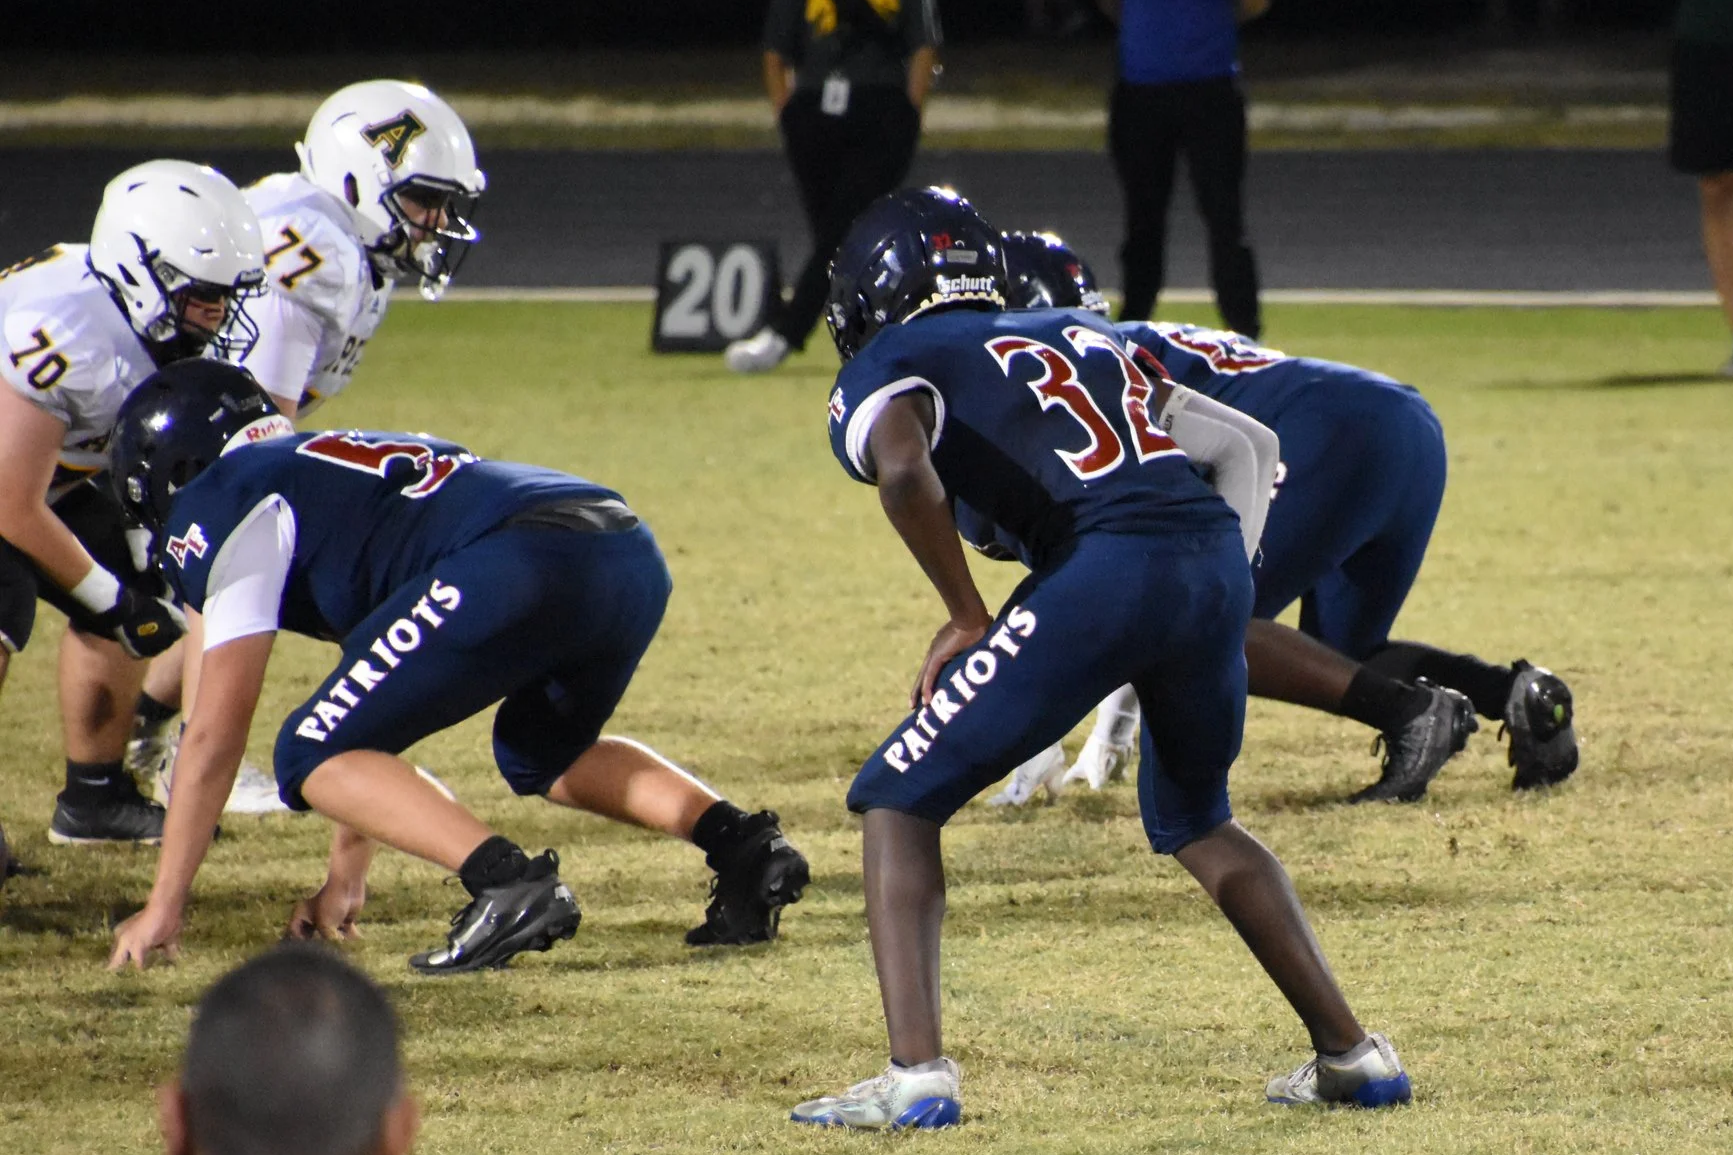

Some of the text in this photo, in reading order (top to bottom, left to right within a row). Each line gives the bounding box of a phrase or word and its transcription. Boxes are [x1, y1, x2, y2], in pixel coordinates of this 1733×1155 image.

[360, 109, 427, 171] A
[264, 224, 324, 291] 77
[661, 244, 764, 338] 20
[9, 326, 70, 391] 70
[984, 325, 1188, 481] 32
[295, 578, 462, 742] PATRIOTS
[883, 605, 1037, 773] PATRIOTS
